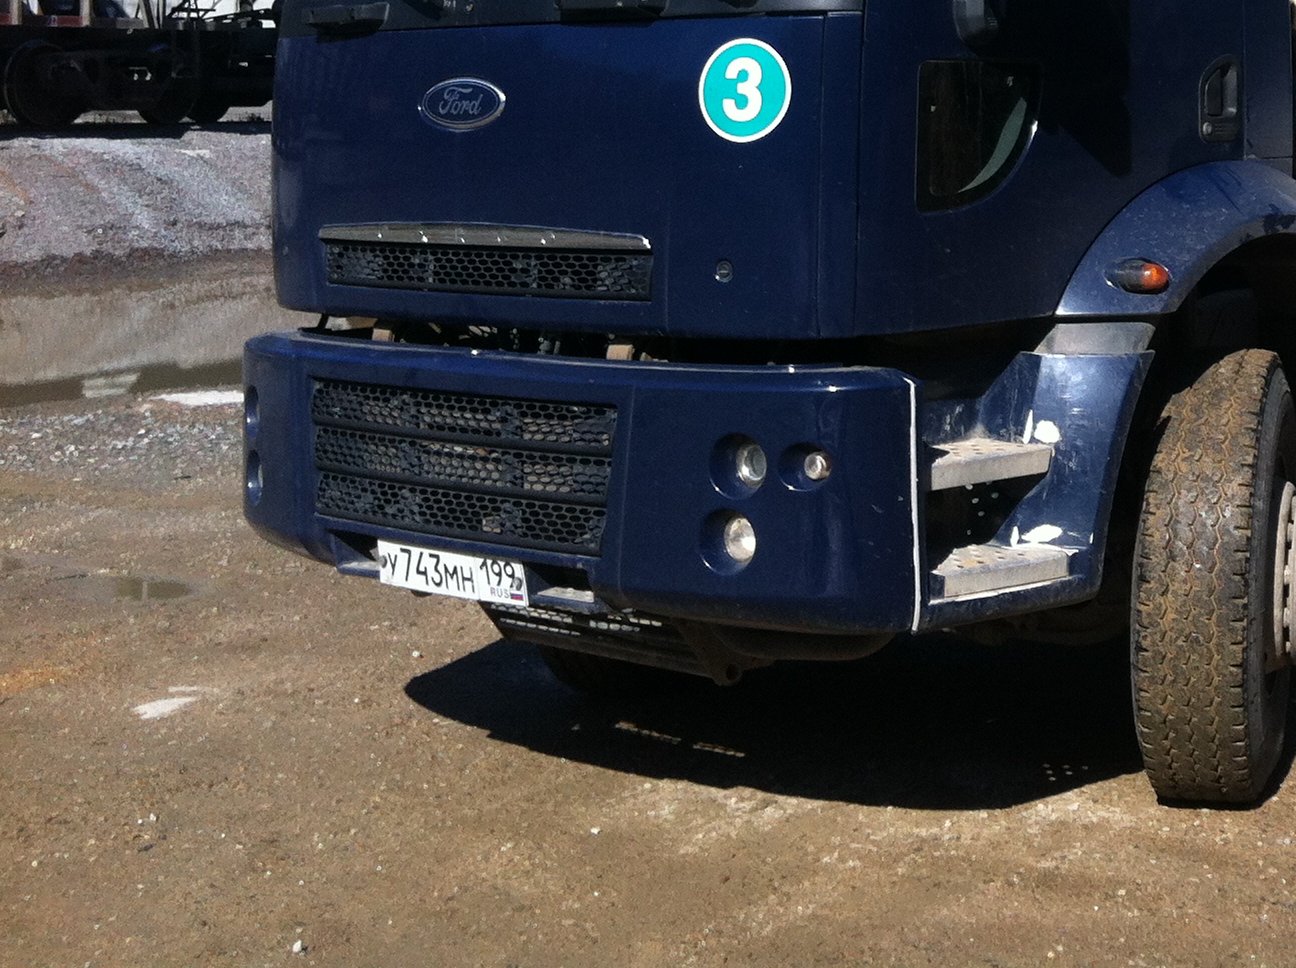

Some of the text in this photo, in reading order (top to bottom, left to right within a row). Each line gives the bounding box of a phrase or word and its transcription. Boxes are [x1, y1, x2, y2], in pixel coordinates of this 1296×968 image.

[438, 86, 484, 115] Ford
[721, 56, 763, 123] 3
[490, 586, 511, 600] RUS
